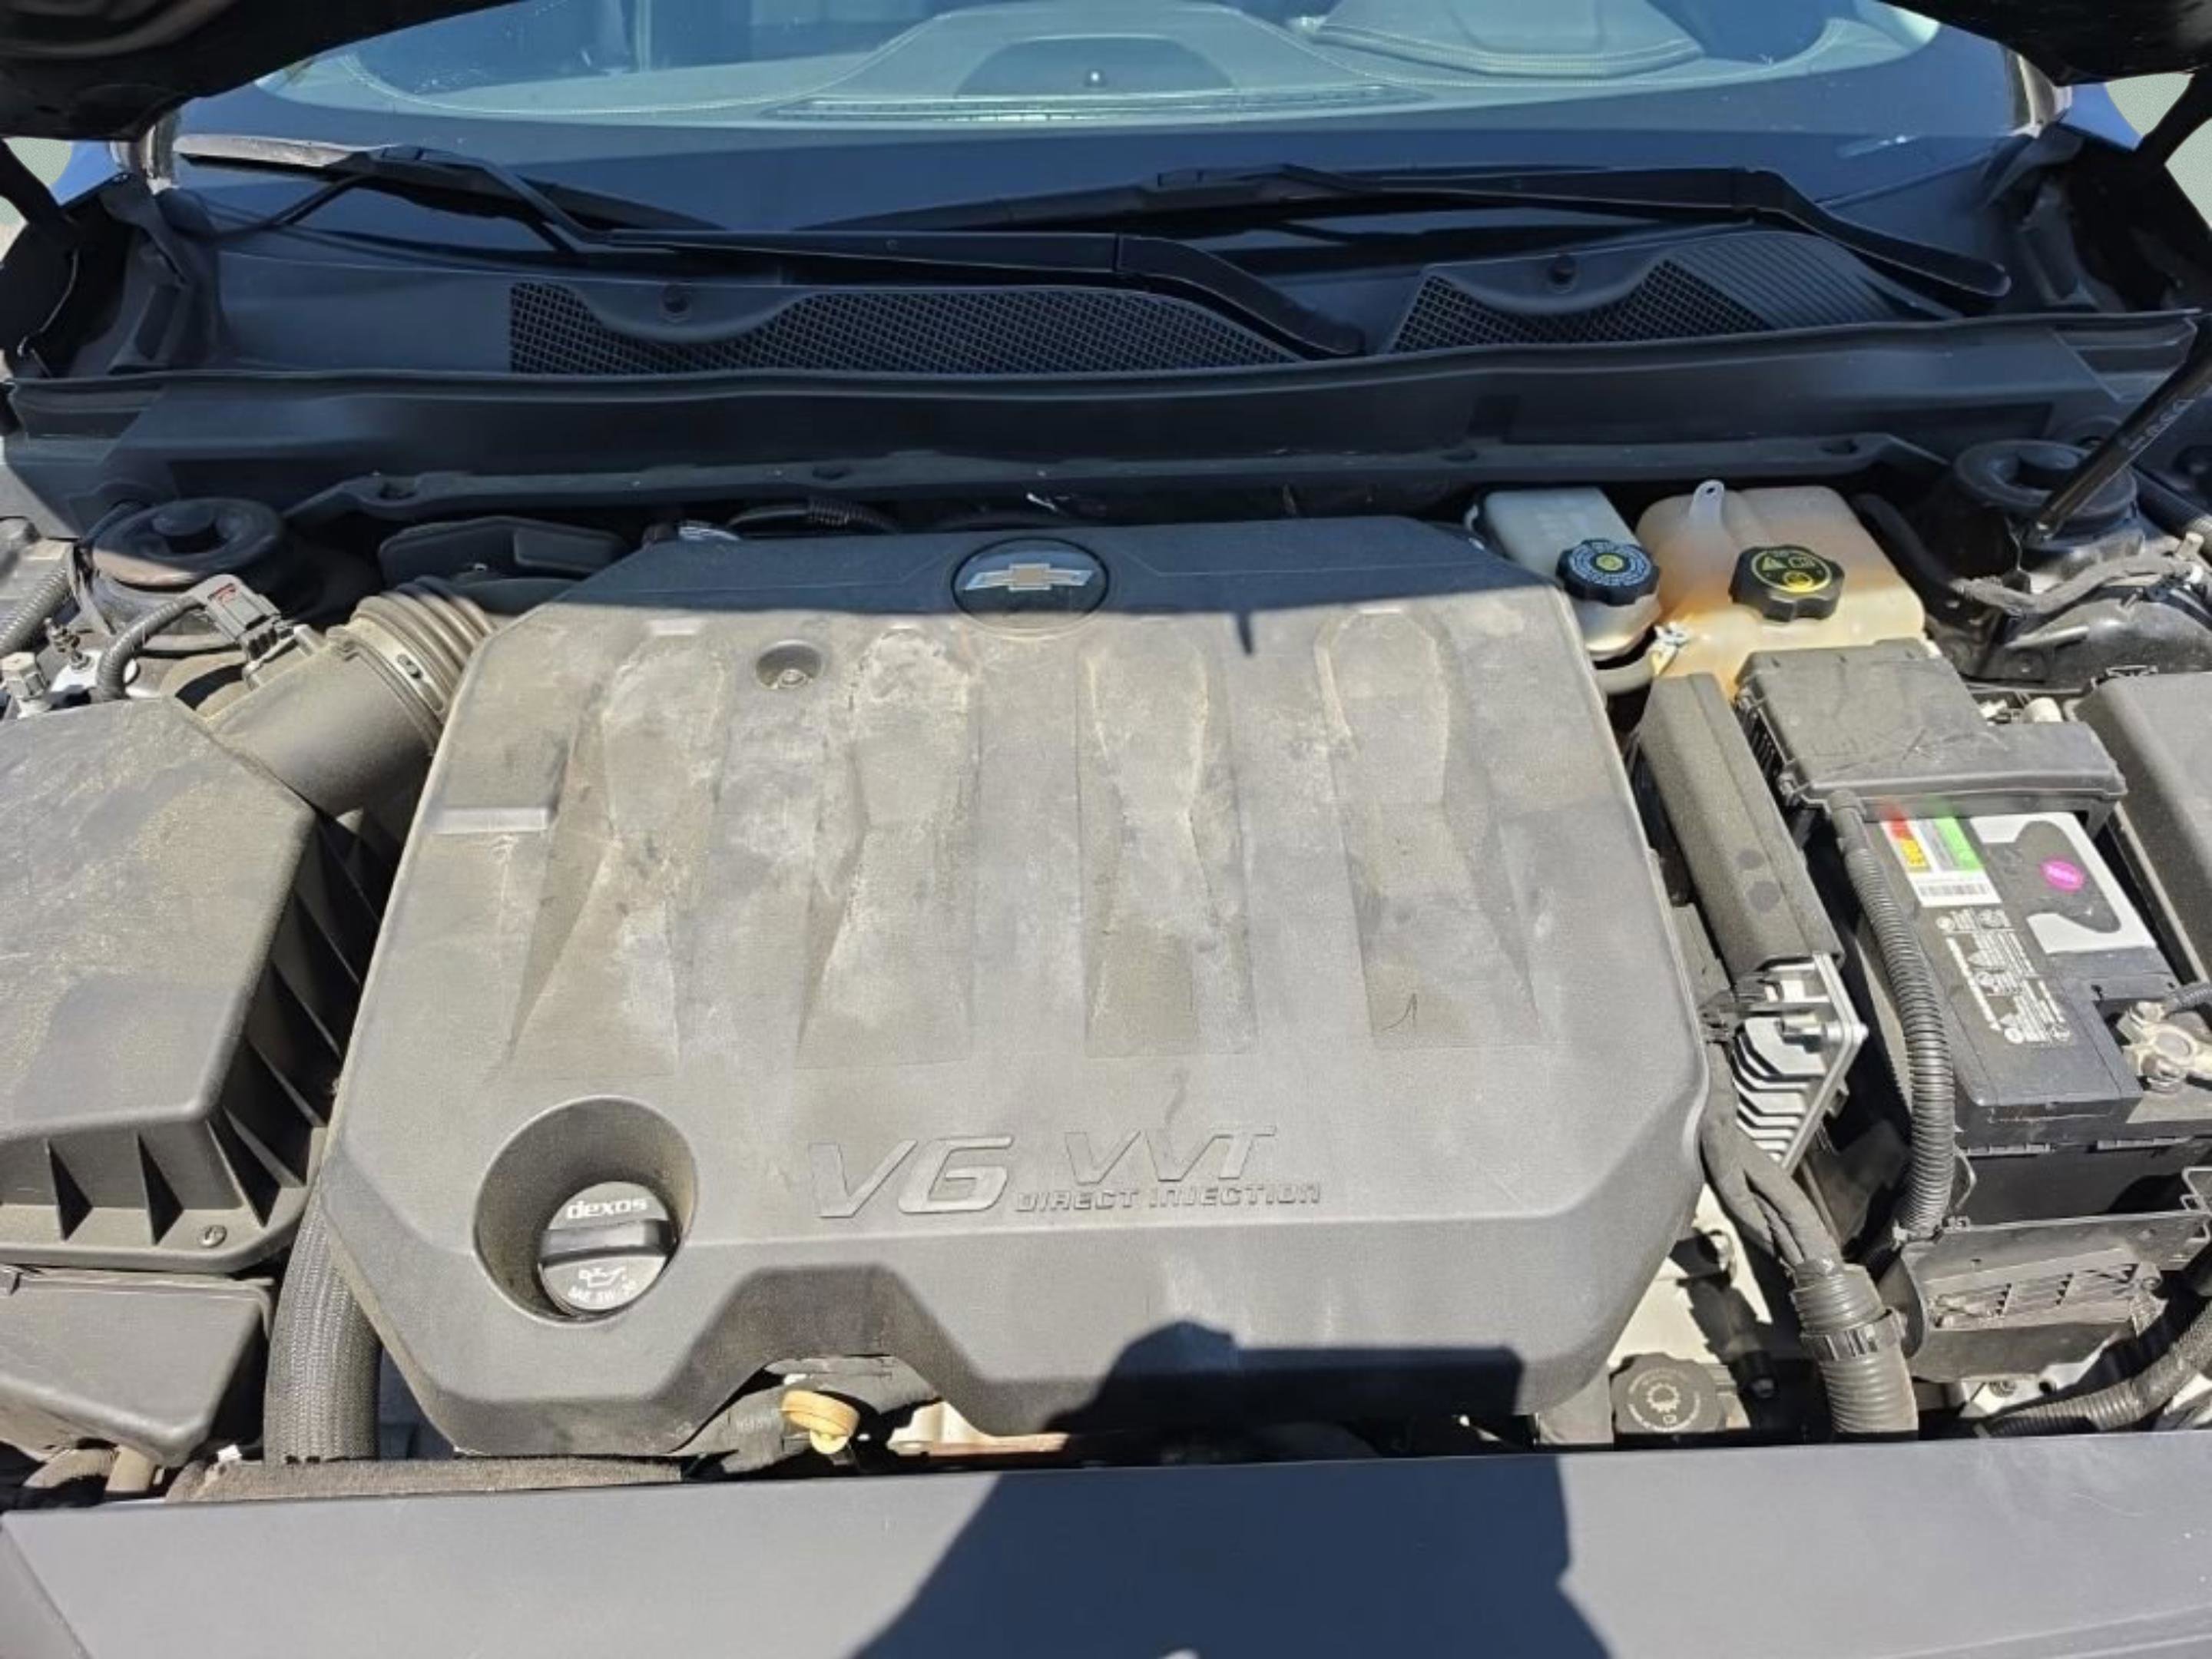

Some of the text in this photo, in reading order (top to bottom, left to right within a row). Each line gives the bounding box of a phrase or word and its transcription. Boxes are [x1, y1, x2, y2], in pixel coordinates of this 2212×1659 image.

[808, 1125, 1277, 1219] V6 VVT
[566, 1199, 647, 1220] dexos
[1015, 1182, 1321, 1212] DIRECT INJECTION
